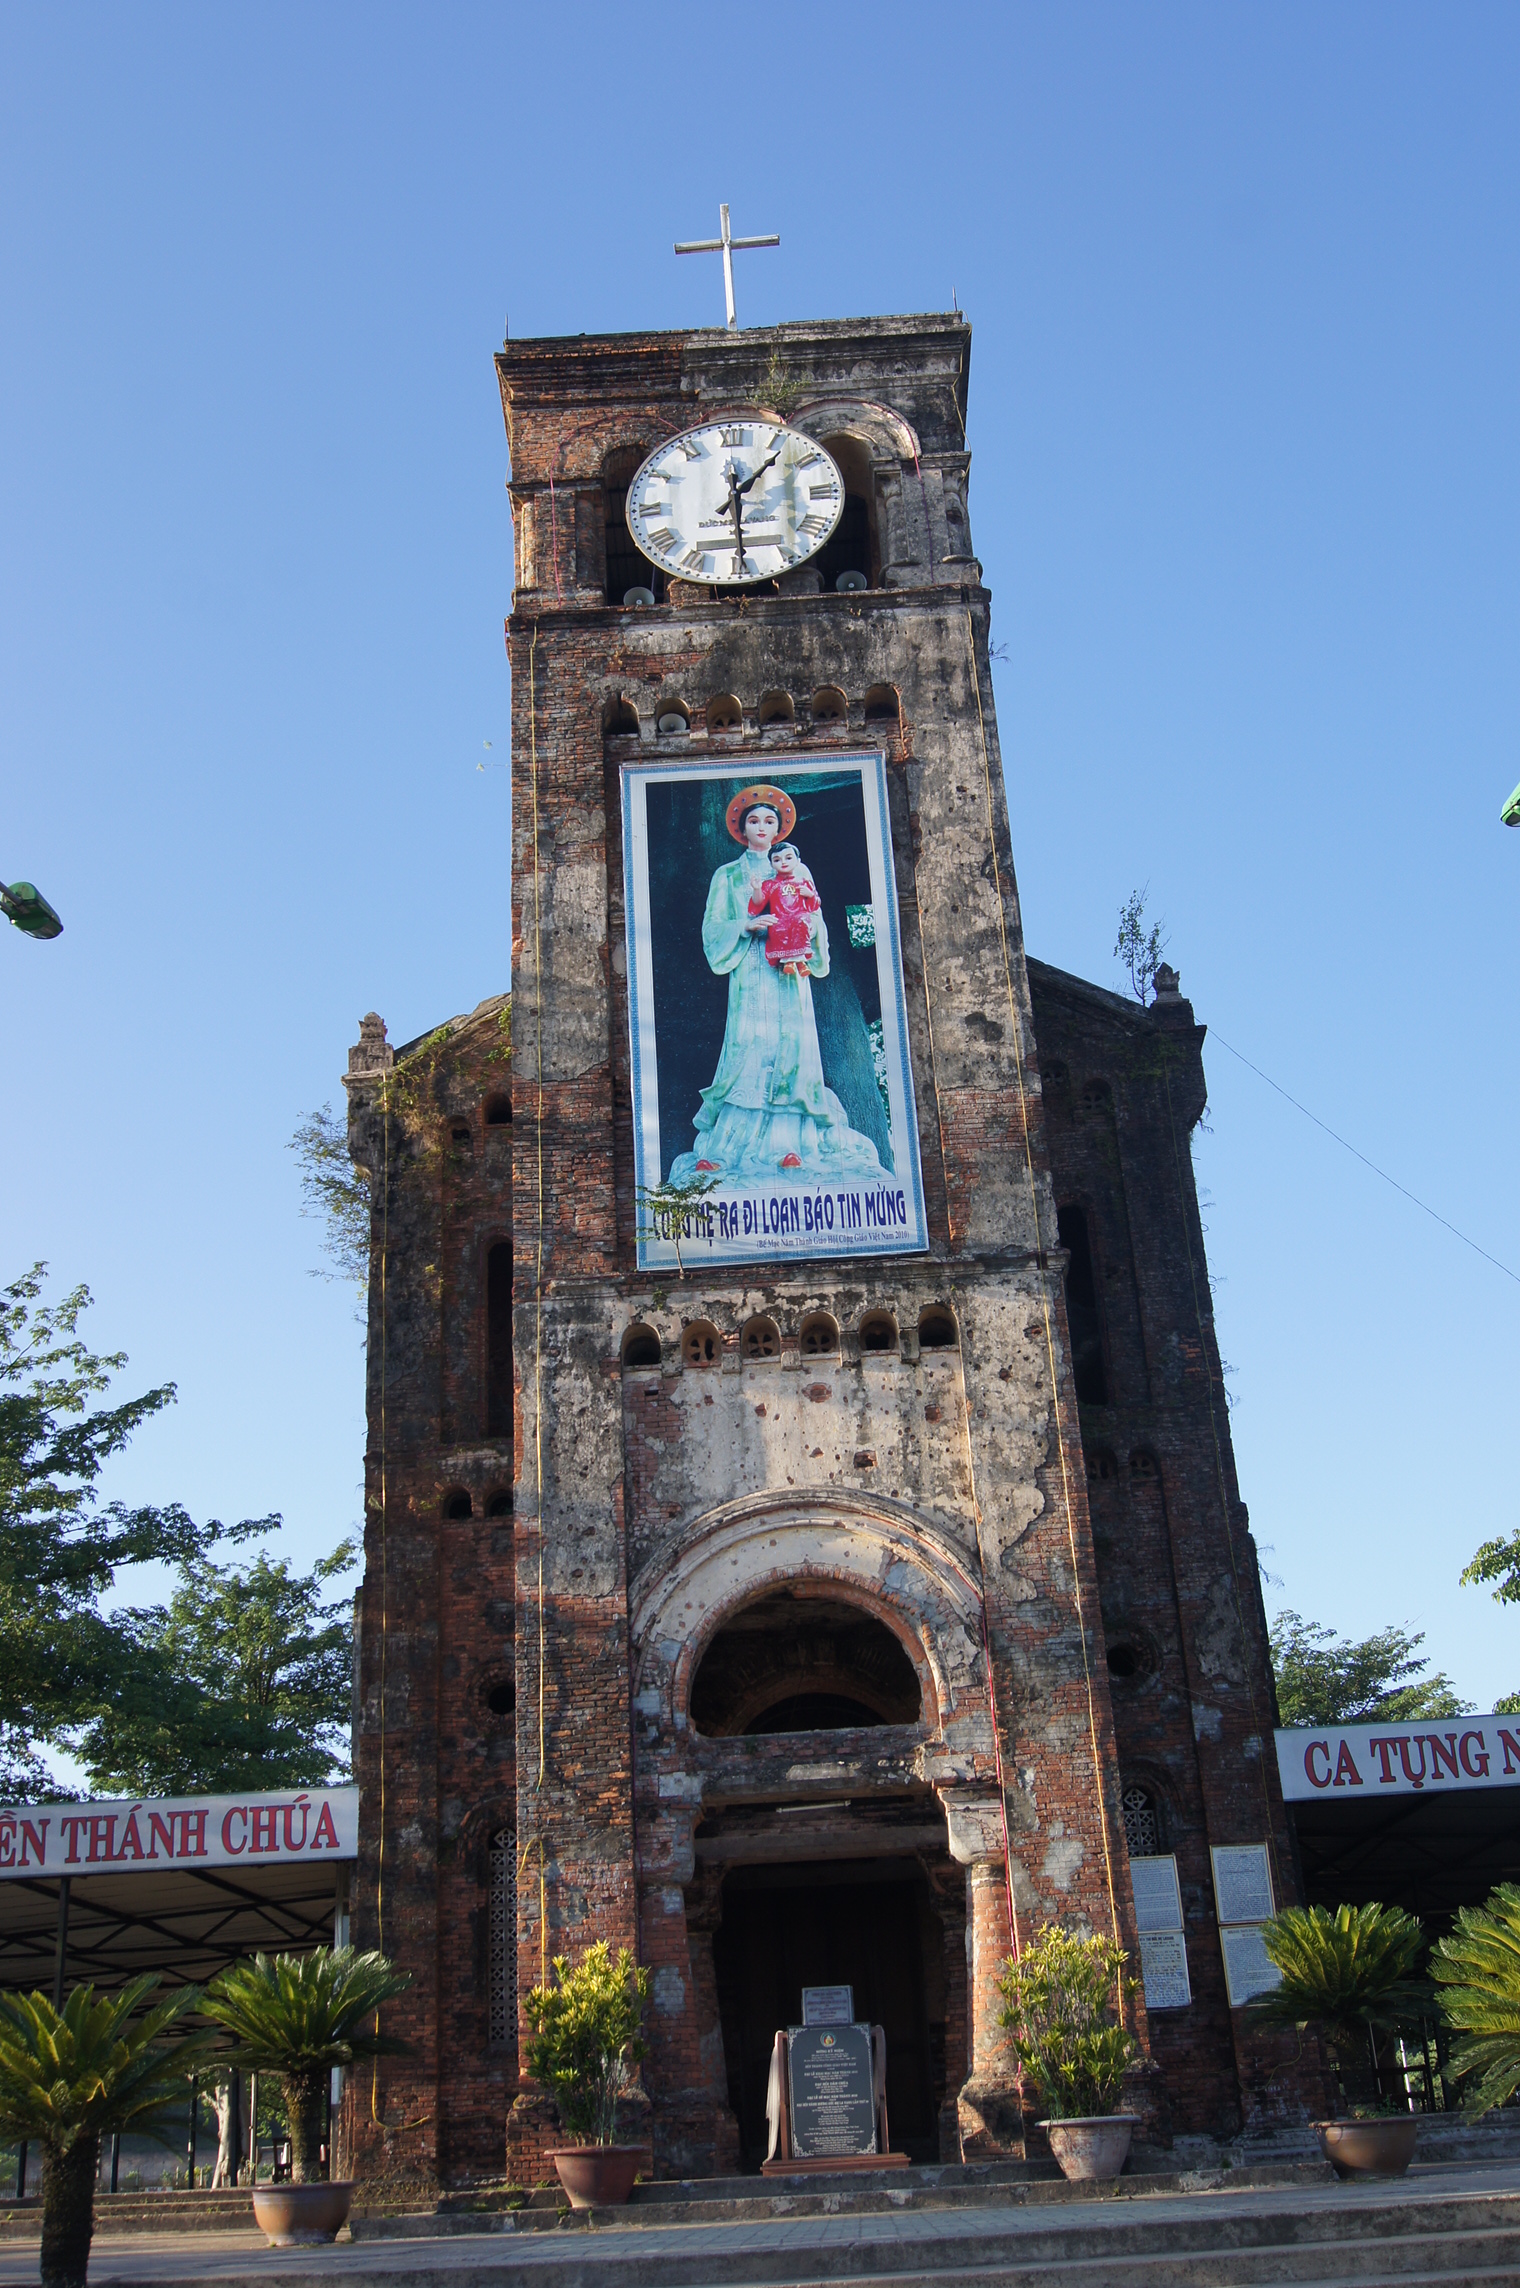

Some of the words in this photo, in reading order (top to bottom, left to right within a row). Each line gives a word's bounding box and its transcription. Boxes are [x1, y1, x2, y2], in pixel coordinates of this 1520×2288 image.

[719, 429, 745, 448] XII
[809, 483, 832, 501] III
[719, 1201, 739, 1241] RA
[743, 1199, 758, 1235] ĐI
[761, 1197, 800, 1236] LOAN
[803, 1186, 834, 1234] BÁO
[837, 1192, 862, 1228] TIN
[864, 1182, 907, 1227] MỪNG
[881, 1231, 895, 1240] Nam
[1304, 1739, 1364, 1788] CA
[1369, 1730, 1491, 1789] TỤNG
[60, 1803, 210, 1864] THÁNH
[221, 1793, 341, 1856] CHÚA
